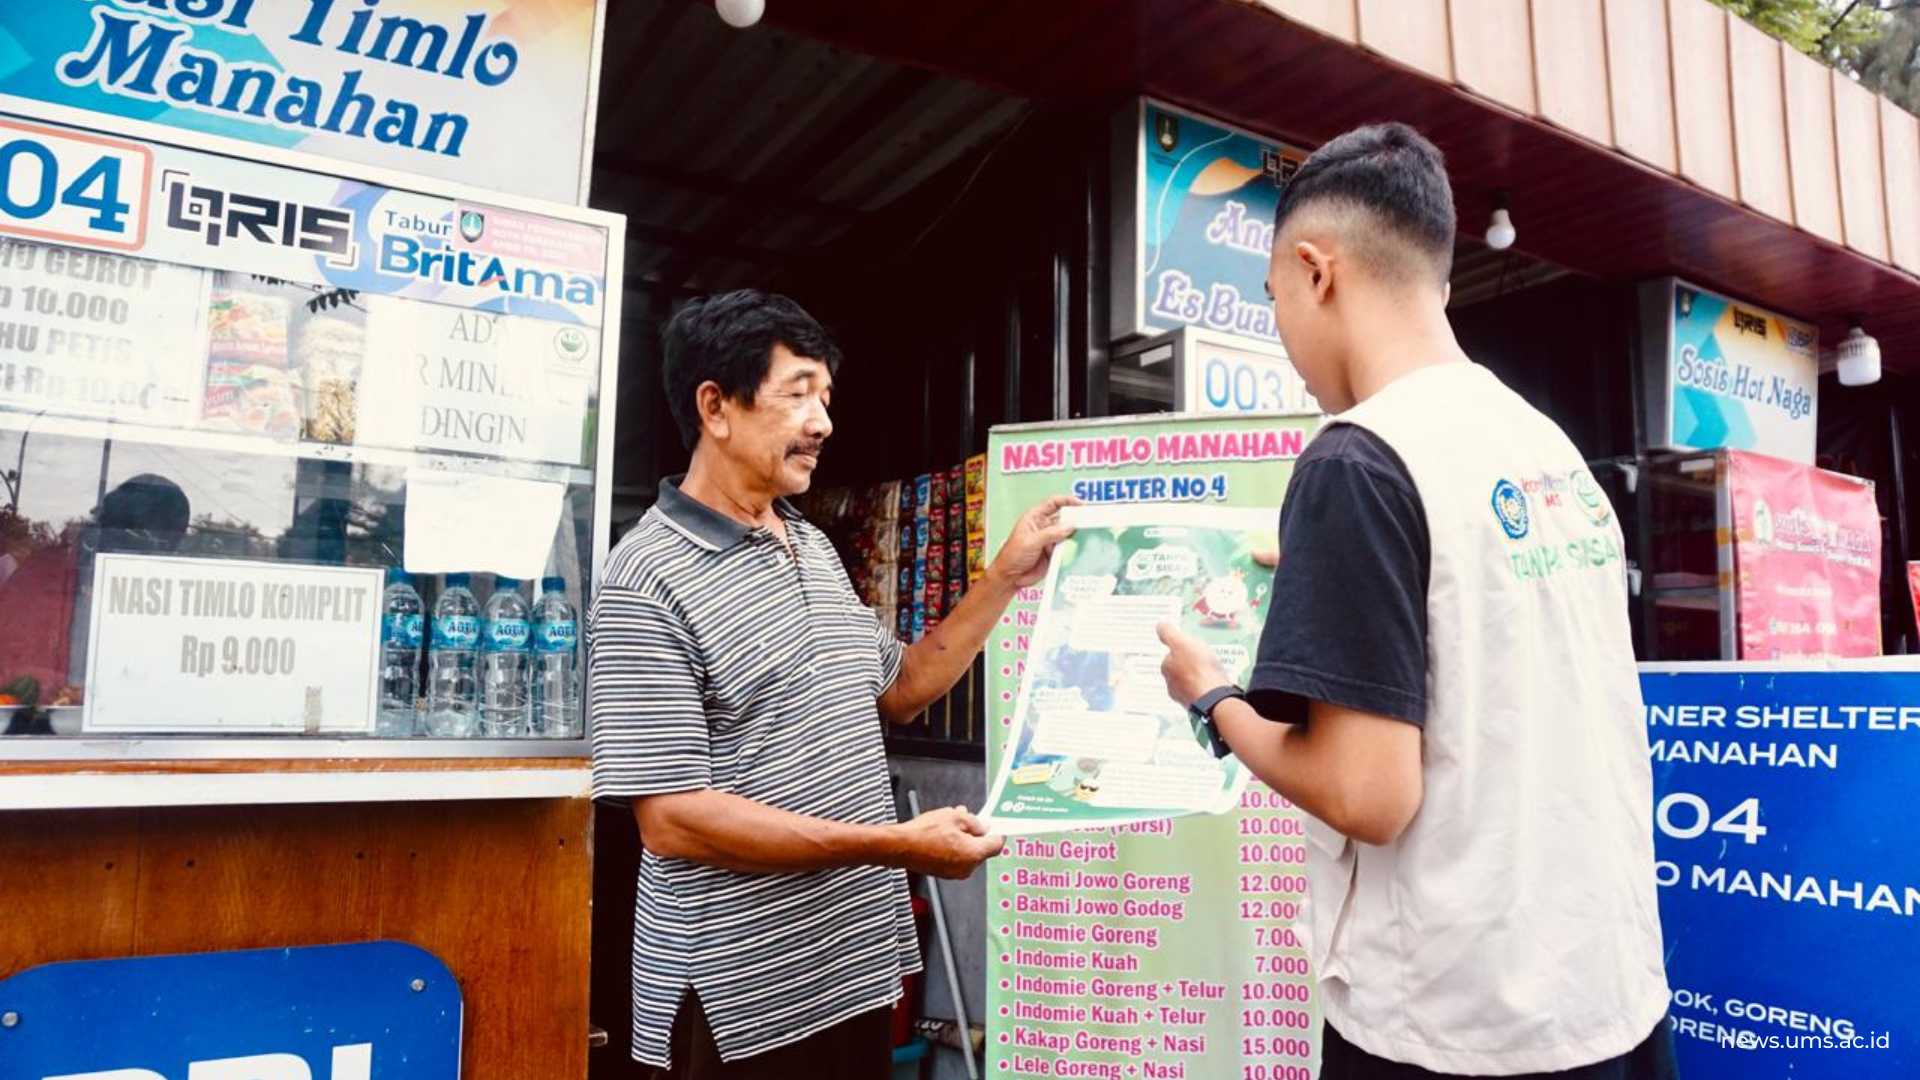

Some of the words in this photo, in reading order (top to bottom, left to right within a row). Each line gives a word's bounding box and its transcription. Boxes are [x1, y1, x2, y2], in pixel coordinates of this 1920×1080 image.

[289, 0, 518, 86] Timlo
[64, 13, 469, 157] Manahan
[165, 180, 351, 256] QRIS
[381, 235, 595, 306] BritAma
[22, 286, 129, 325] 10.000
[1156, 275, 1201, 318] Es
[449, 311, 498, 344] AD
[1678, 347, 1728, 391] Sosis
[1733, 365, 1765, 401] Hot
[1767, 376, 1811, 420] Naga
[421, 405, 526, 444] DINGIN
[1003, 444, 1063, 470] NASI
[1070, 438, 1151, 464] TIMLO
[1157, 431, 1303, 460] MANAHAN
[1074, 478, 1166, 501] SHELTER
[1171, 477, 1206, 498] NO
[1211, 475, 1225, 497] 4
[109, 576, 171, 616] NASI
[178, 580, 256, 619] TIMLO
[262, 583, 367, 622] KOMPLIT
[496, 624, 526, 637] AQUA
[181, 636, 215, 677] Rp
[221, 637, 296, 674] 9.000
[1657, 792, 1766, 844] 04
[1016, 839, 1055, 858] Tahu
[1060, 841, 1116, 862] Gejrot
[1240, 844, 1306, 863] 10.000
[1016, 870, 1070, 888] Bakmi
[1074, 873, 1119, 889] Jowo
[1123, 873, 1190, 893] Goreng
[1240, 875, 1307, 893] 12.000
[1016, 895, 1070, 914] Bakmi
[1074, 897, 1119, 915] Jowo
[1123, 898, 1184, 919] Godog
[1016, 922, 1086, 942] Indomie
[1092, 924, 1158, 947] Goreng
[1255, 928, 1303, 948] 7.00
[1016, 950, 1086, 969] Indomie
[1092, 952, 1137, 970] Kuah
[1255, 957, 1309, 975] 7.000
[1016, 975, 1086, 995] Indomie
[1092, 979, 1157, 1000] Goreng
[1163, 984, 1173, 994] +
[1179, 981, 1225, 999] Telur
[1242, 982, 1309, 1001] 10.000
[1671, 990, 1718, 1016] OK,
[1016, 1002, 1086, 1022] Indomie
[1092, 1005, 1138, 1024] Kuah
[1144, 1012, 1153, 1021] +
[1159, 1007, 1206, 1025] Telur
[1242, 1010, 1310, 1029] 10.000
[1015, 1028, 1070, 1052] Kakap
[1075, 1031, 1142, 1055] Goreng
[1147, 1038, 1157, 1048] +
[1164, 1033, 1205, 1052] Nasi
[1242, 1038, 1310, 1058] 15.000
[1015, 1056, 1049, 1075] Lele
[1054, 1059, 1121, 1080] Goreng
[1127, 1066, 1137, 1075] +
[1143, 1060, 1184, 1079] Nasi
[1243, 1065, 1310, 1080] 10.000
